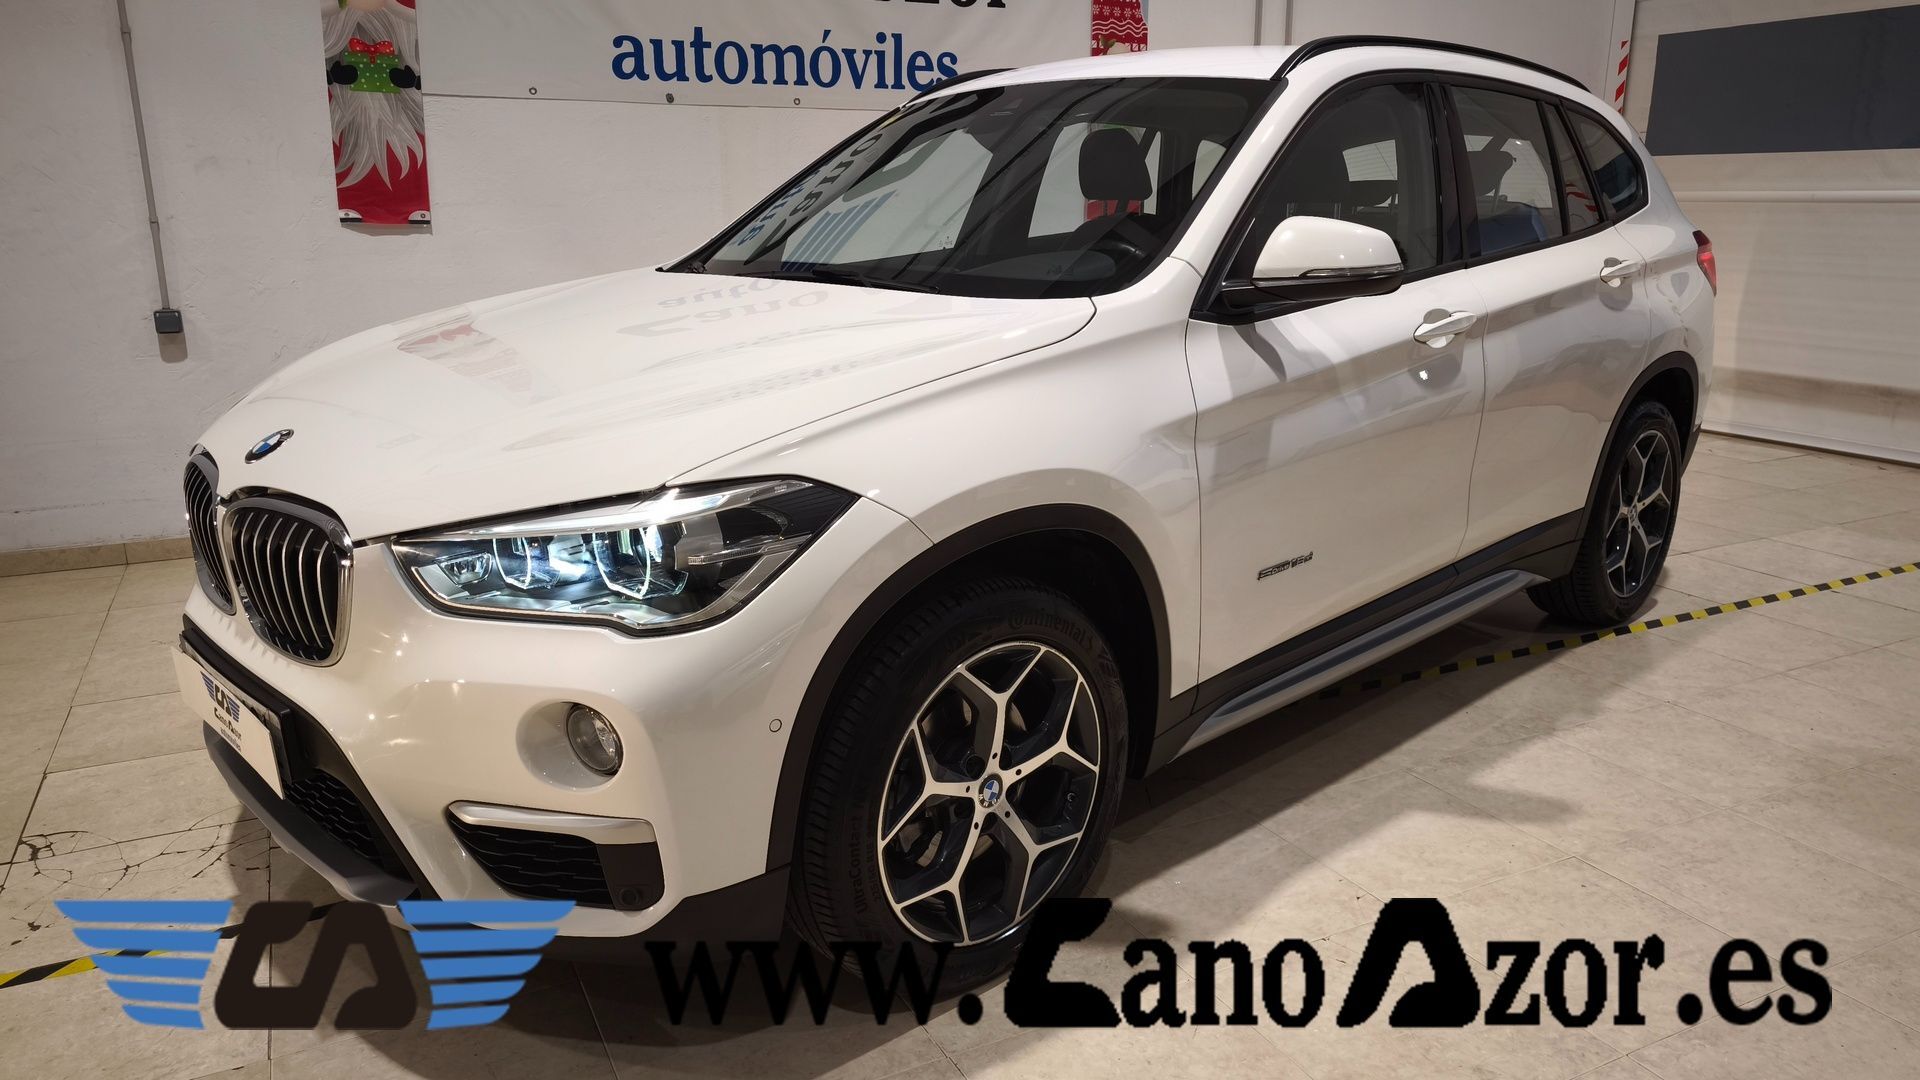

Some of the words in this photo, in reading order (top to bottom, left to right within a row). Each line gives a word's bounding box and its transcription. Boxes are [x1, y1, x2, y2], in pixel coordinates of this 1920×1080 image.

[611, 27, 959, 92] automóviles
[1007, 608, 1088, 645] Continental
[847, 815, 868, 915] UltraContact
